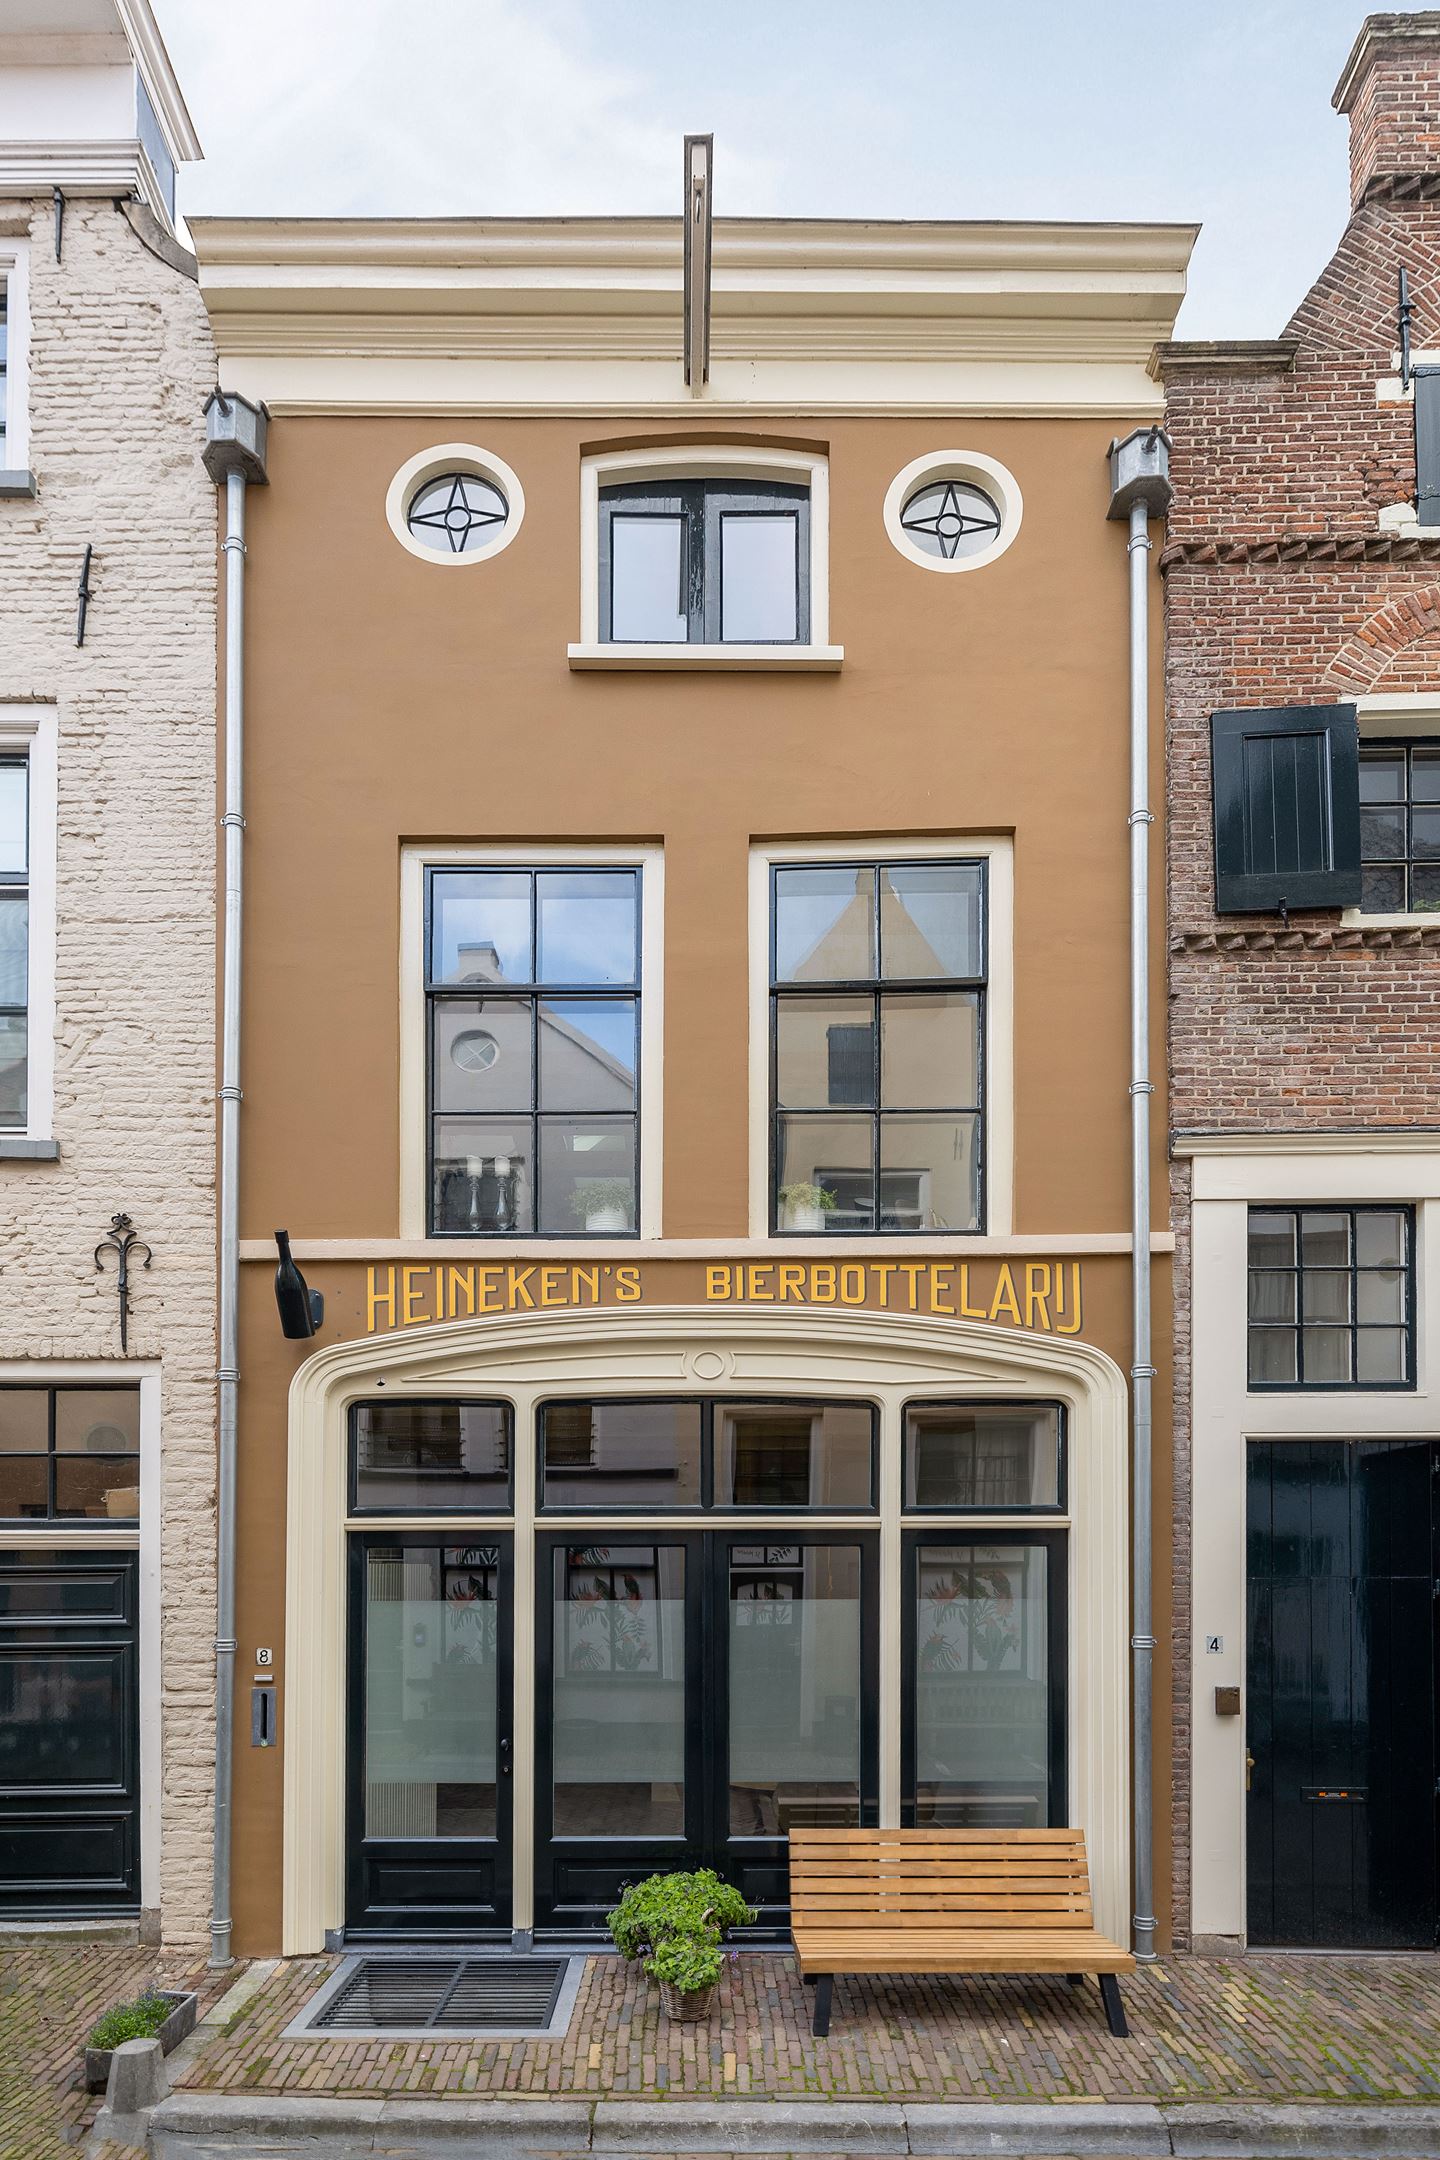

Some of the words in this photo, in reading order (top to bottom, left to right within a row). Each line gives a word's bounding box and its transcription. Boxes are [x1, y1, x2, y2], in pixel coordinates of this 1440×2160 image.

[367, 1266, 642, 1333] HEINEKEN'S
[706, 1263, 1082, 1334] BIERBOTTELARIJ
[1209, 1637, 1220, 1652] 4
[259, 1649, 269, 1664] 8
